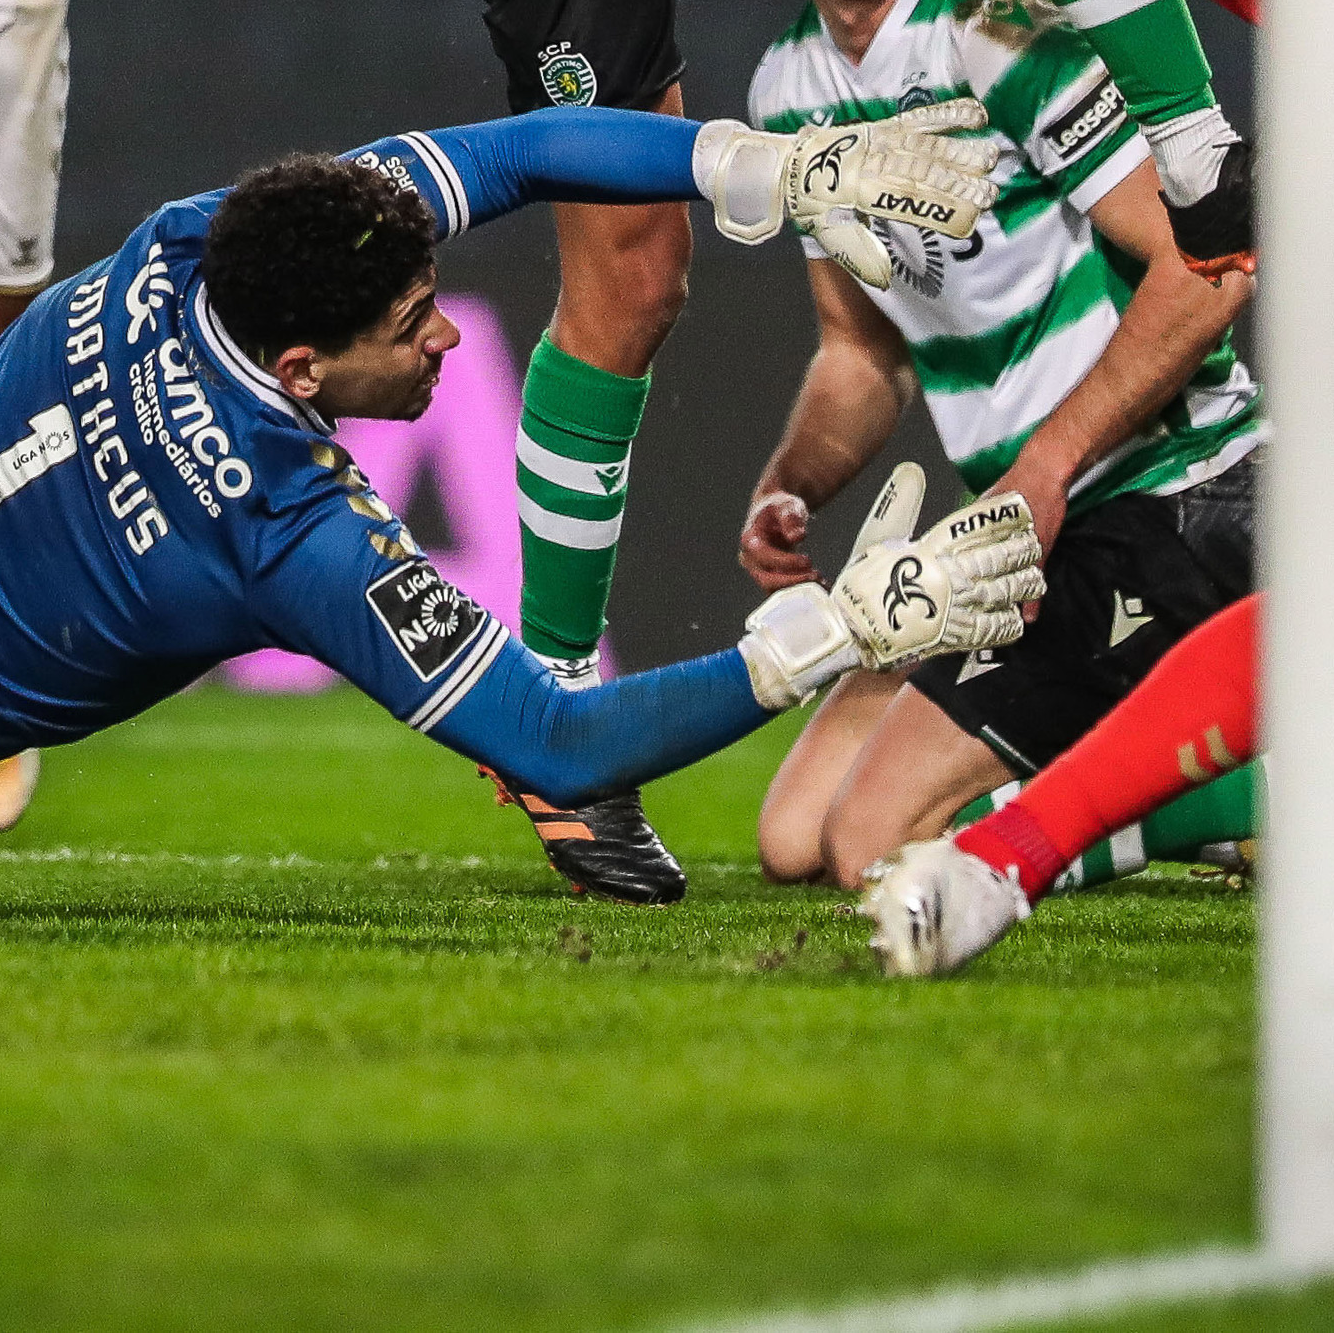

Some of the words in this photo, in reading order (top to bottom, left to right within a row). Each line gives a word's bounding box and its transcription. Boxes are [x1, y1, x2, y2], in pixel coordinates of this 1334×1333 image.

[537, 41, 572, 62] SCP
[546, 60, 583, 80] SPORTING
[901, 71, 929, 87] SCP
[871, 192, 957, 224] RINAT
[66, 274, 169, 556] MATHEUS
[129, 363, 154, 446] crédito
[158, 337, 253, 499] amco
[12, 450, 38, 471] LIGA
[39, 431, 70, 454] NOS
[143, 348, 222, 519] intermediários
[950, 504, 1020, 539] RINAT
[396, 570, 438, 602] LIGA
